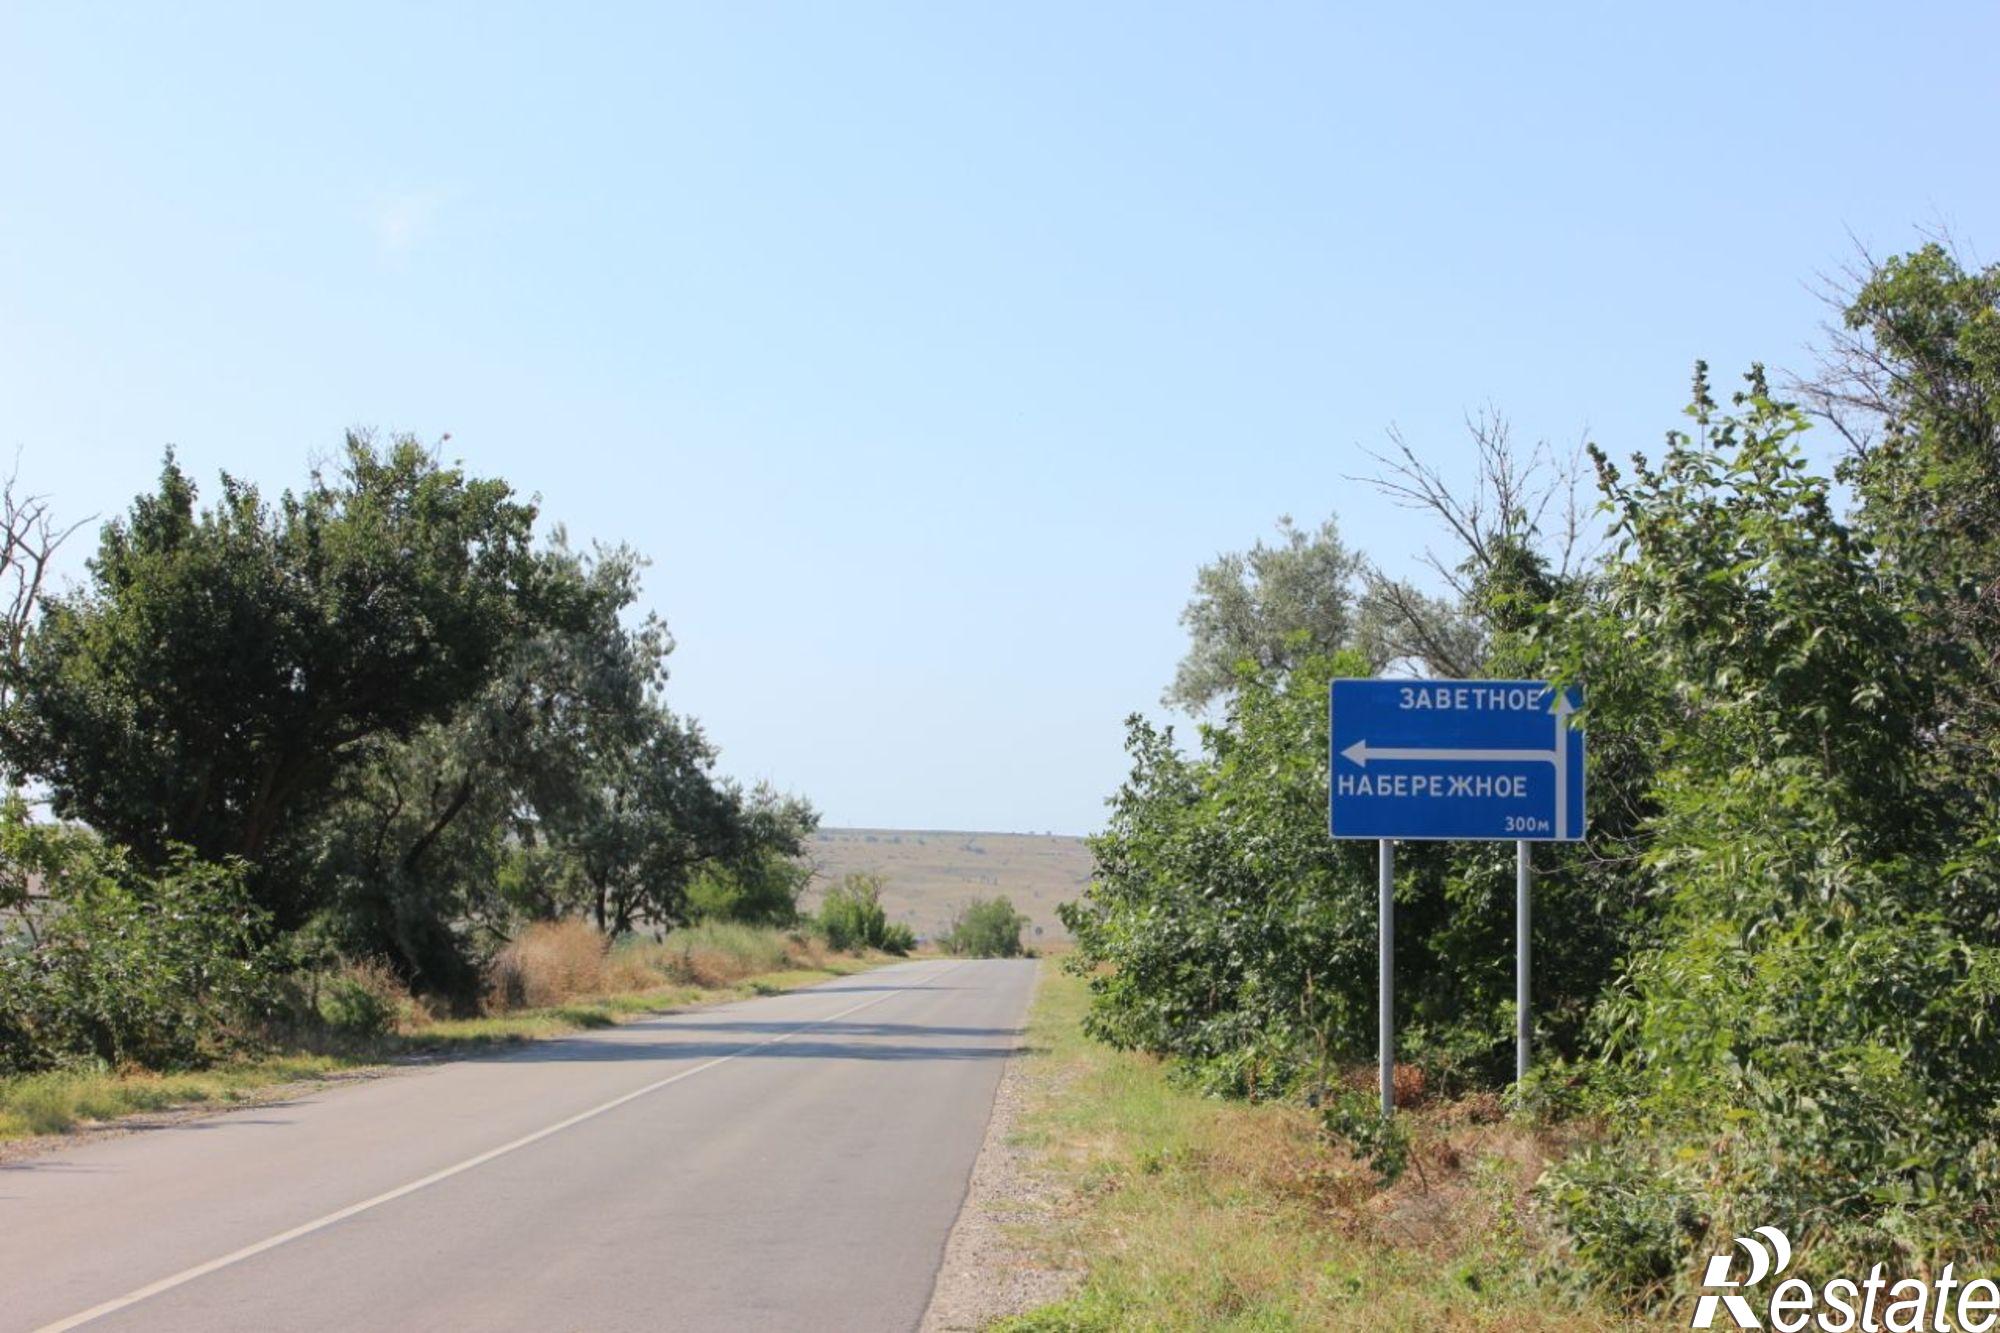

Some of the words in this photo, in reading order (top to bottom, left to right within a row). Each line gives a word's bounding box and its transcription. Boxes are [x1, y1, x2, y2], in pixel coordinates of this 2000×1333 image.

[1399, 687, 1541, 711] ЗАВЕТНОЕ
[1337, 774, 1527, 798] НАБЕРЕЖНОЕ
[1505, 816, 1550, 832] 300м
